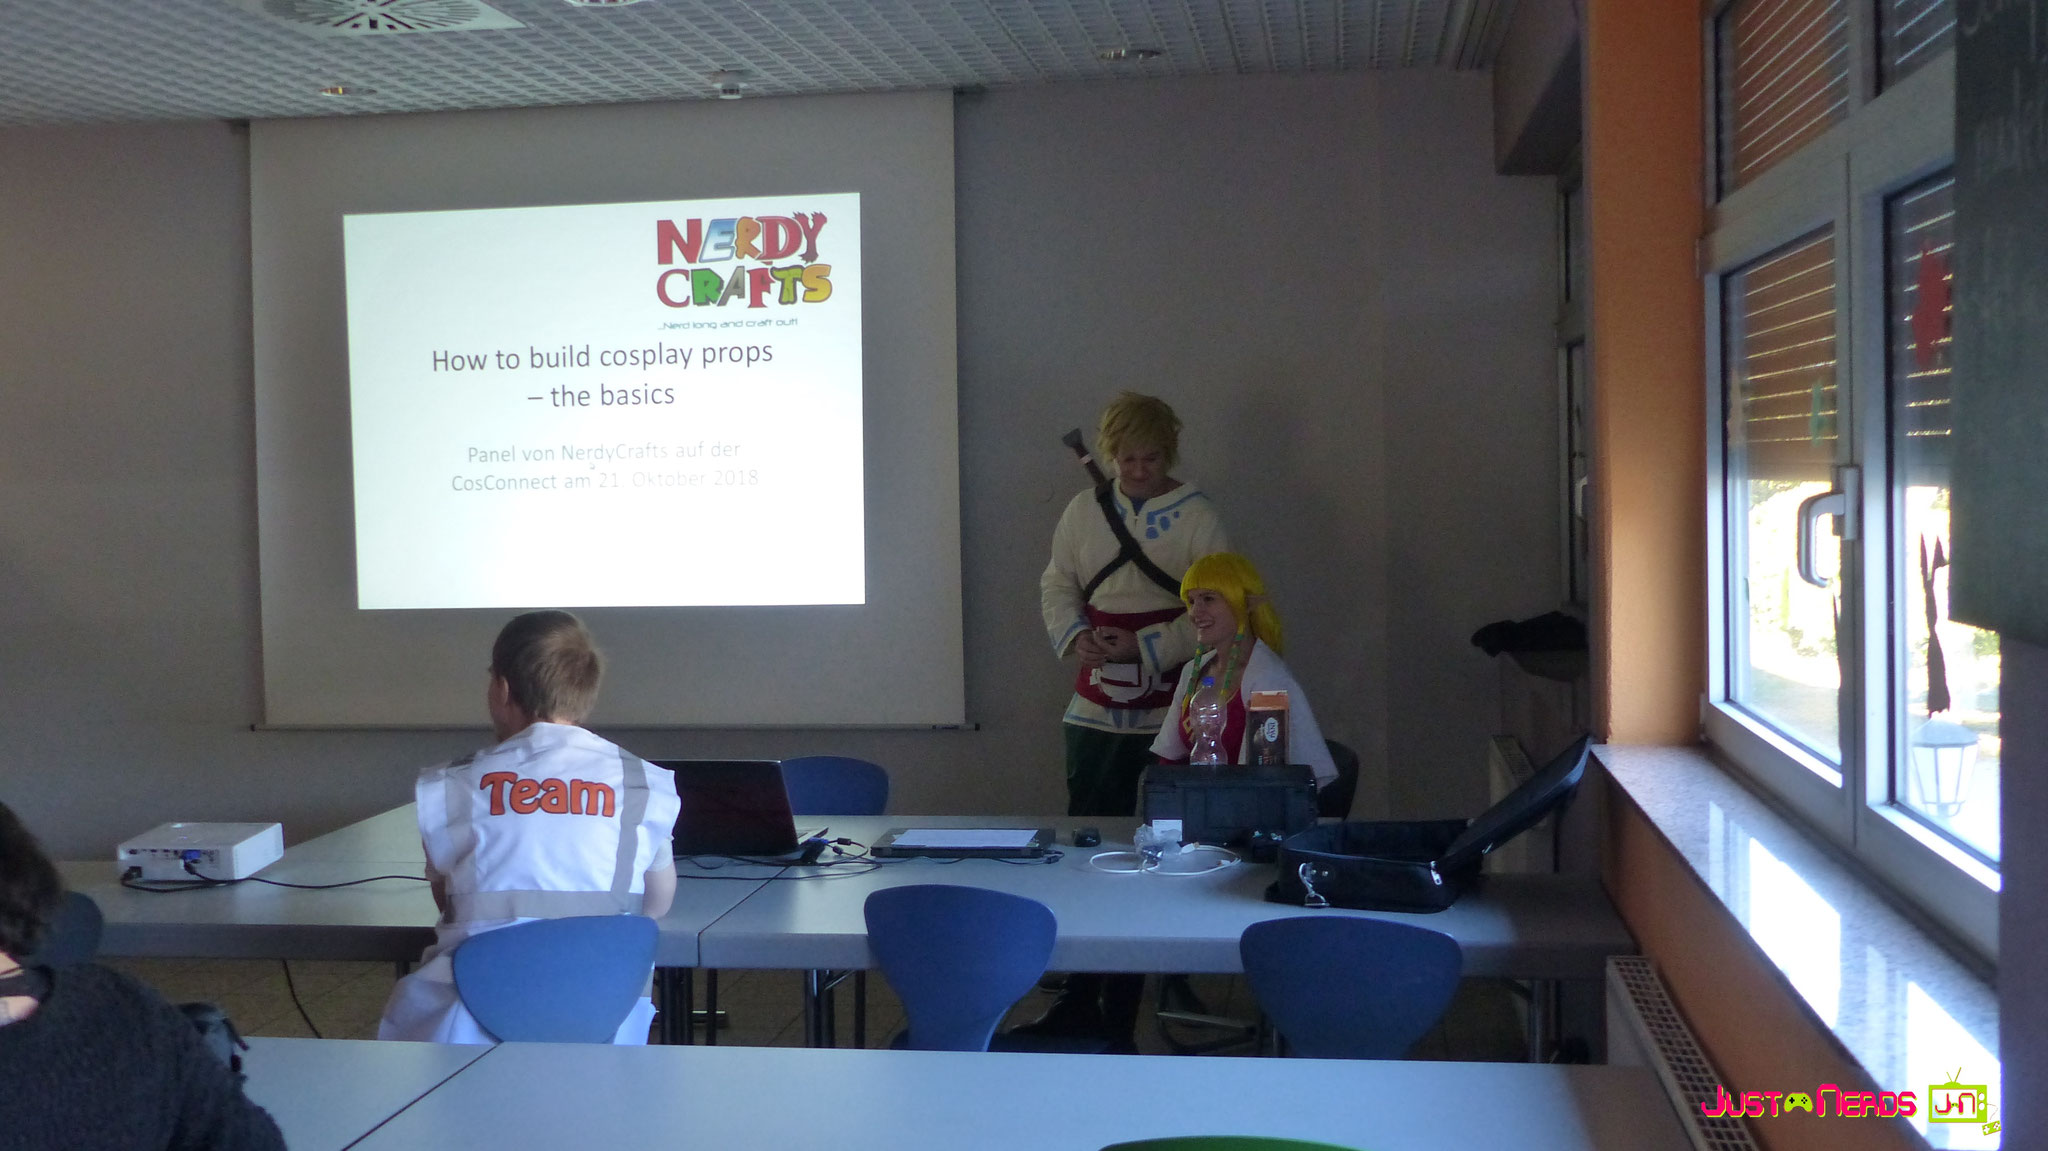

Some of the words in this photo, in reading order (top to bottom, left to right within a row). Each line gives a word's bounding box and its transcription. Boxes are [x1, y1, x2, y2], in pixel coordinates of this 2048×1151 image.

[657, 211, 828, 265] NERDY
[656, 264, 833, 309] CRAFTS
[432, 350, 488, 372] How
[495, 350, 520, 370] to
[530, 344, 590, 369] build
[600, 341, 693, 371] cosplay
[702, 345, 773, 369] props
[550, 384, 591, 407] the
[601, 383, 675, 406] basics
[468, 445, 516, 463] Panel
[522, 448, 555, 462] von
[561, 441, 668, 463] NerdyCrafts
[675, 440, 705, 458] auf
[711, 440, 741, 458] der
[451, 474, 557, 491] CosConnect
[564, 475, 591, 489] am
[632, 470, 705, 487] Oktober
[713, 469, 759, 486] 2018
[479, 771, 616, 818] Team
